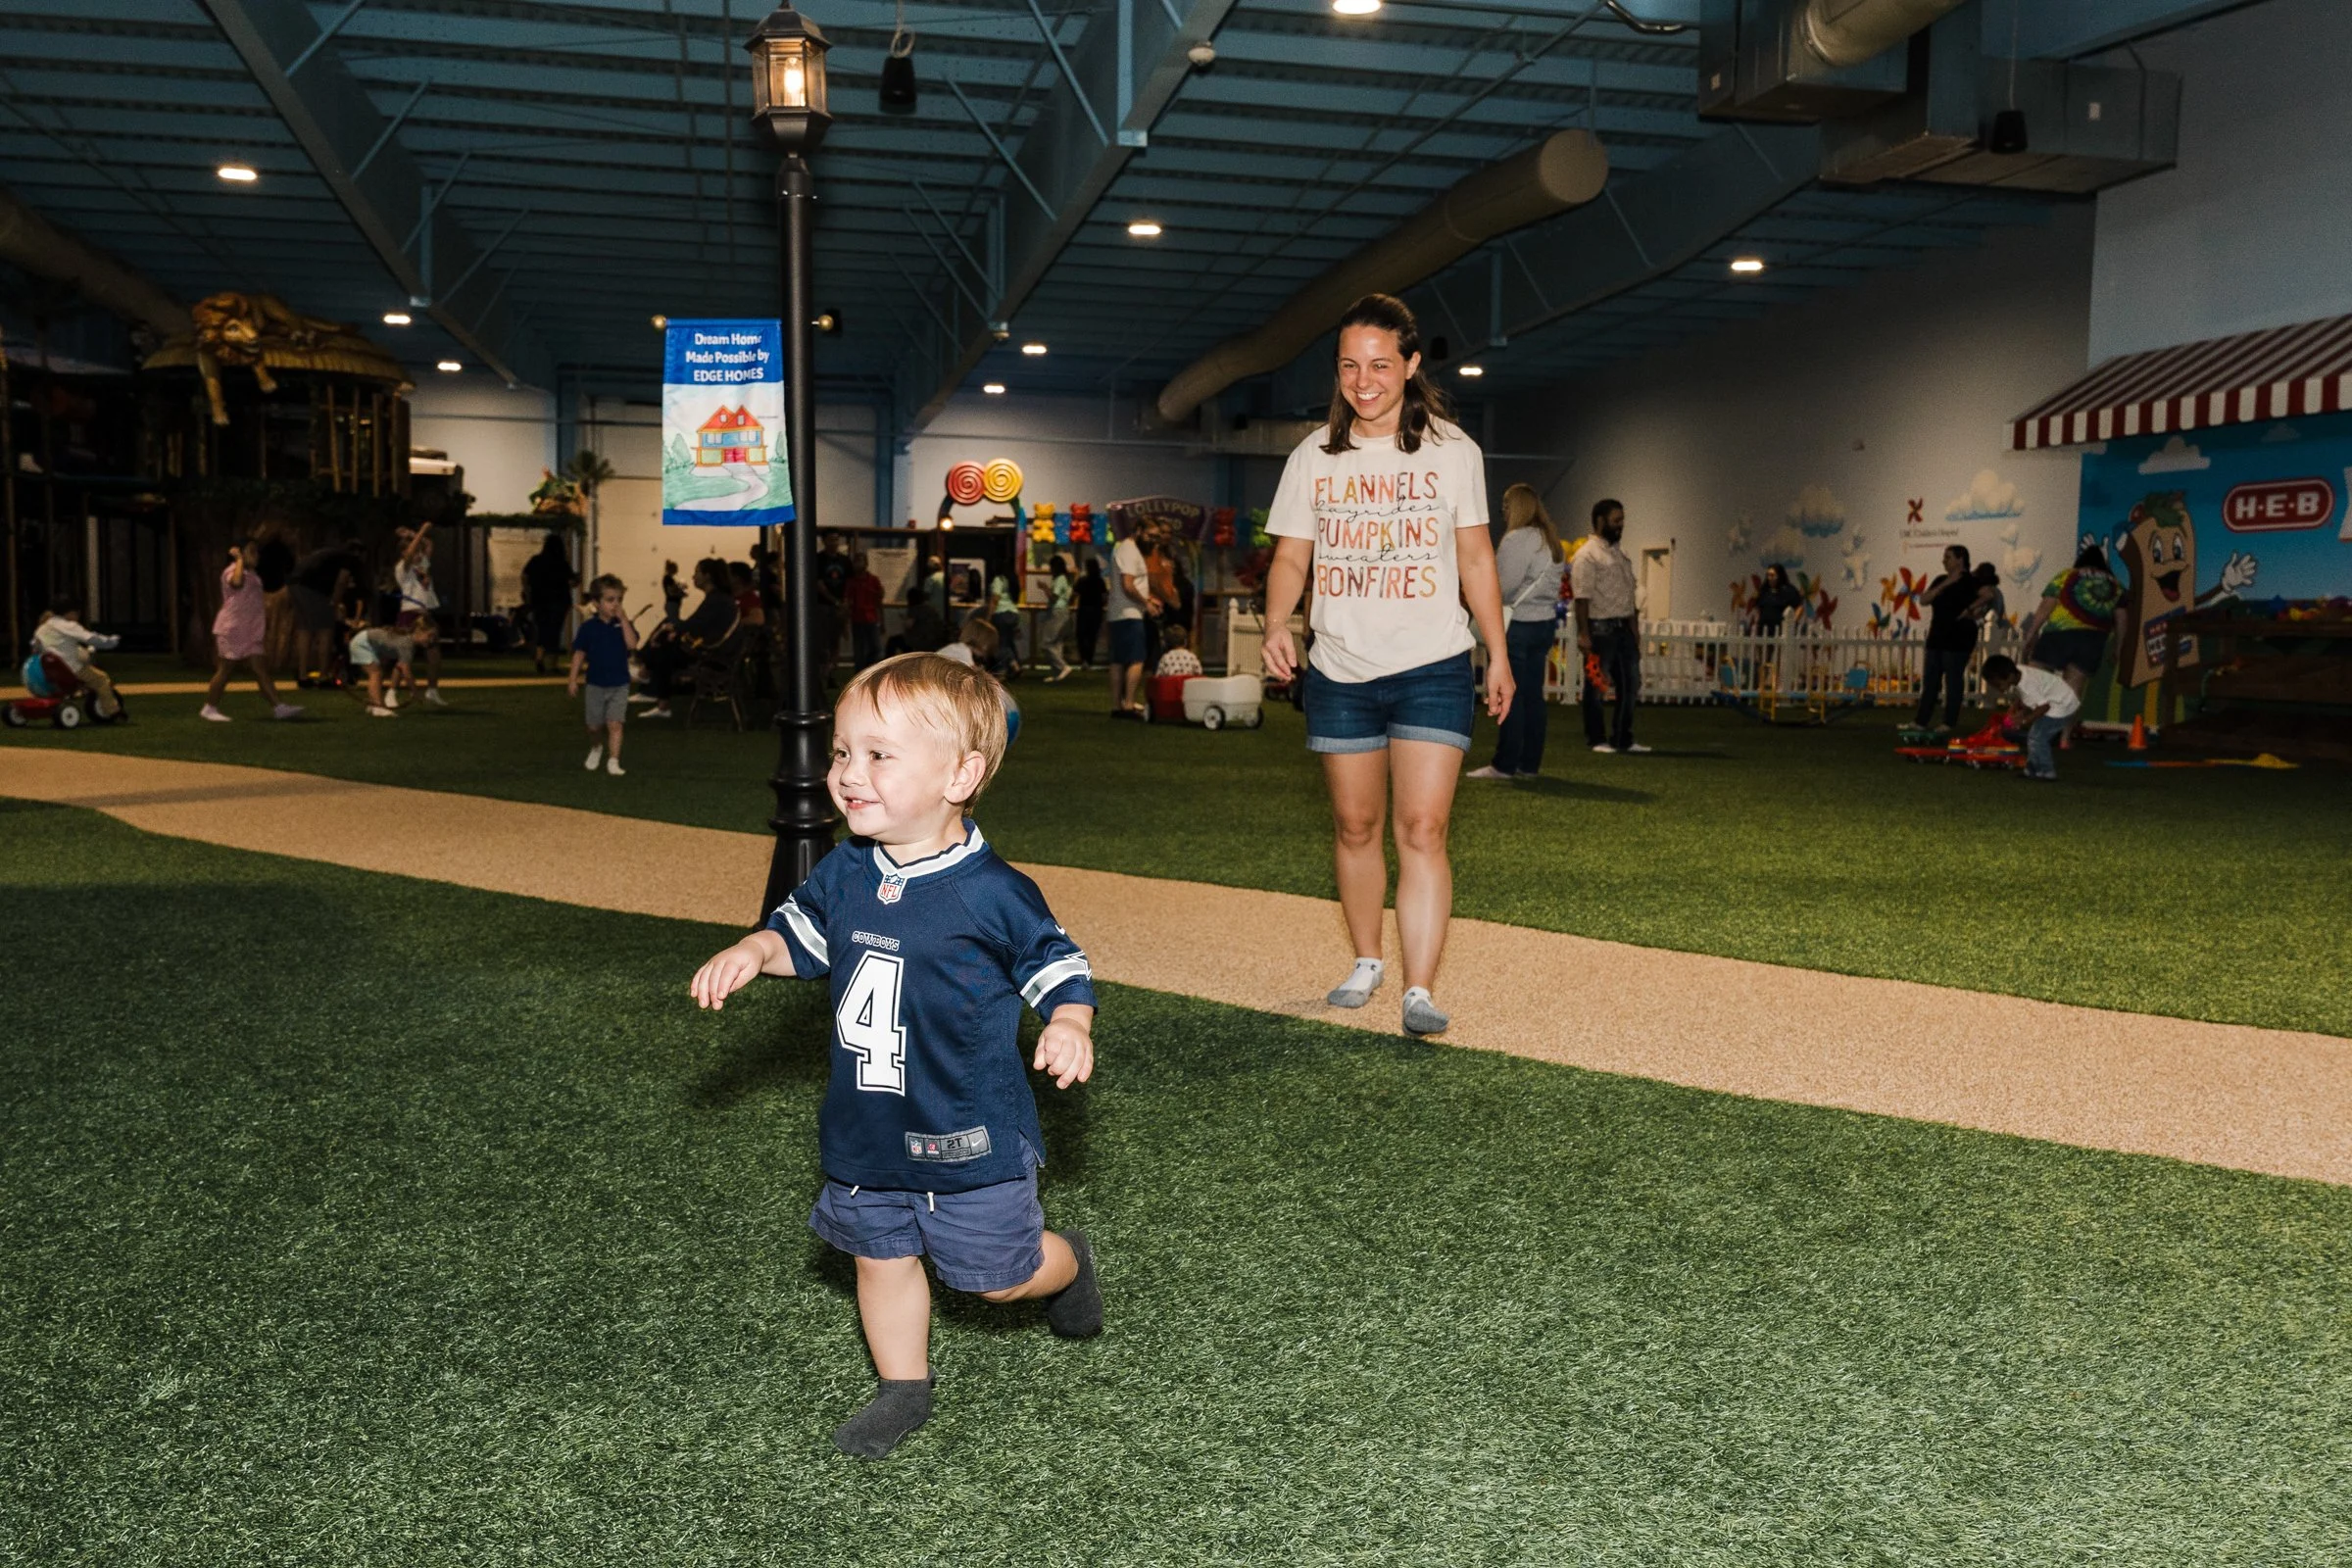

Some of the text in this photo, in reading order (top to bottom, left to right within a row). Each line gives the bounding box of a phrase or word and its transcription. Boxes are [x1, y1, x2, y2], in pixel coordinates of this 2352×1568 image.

[695, 333, 729, 345] Dream
[686, 349, 770, 364] Made Possible by
[694, 368, 763, 381] EDGE HOMES
[1315, 471, 1440, 506] FLANNELS
[1125, 500, 1200, 518] LOLLYPOP
[1318, 516, 1440, 550] PUMPKINS
[1317, 564, 1437, 599] BONFIRES
[882, 884, 898, 899] NFL
[852, 930, 900, 952] COWBOYS
[836, 950, 906, 1098] 4
[947, 1137, 962, 1150] 2T
